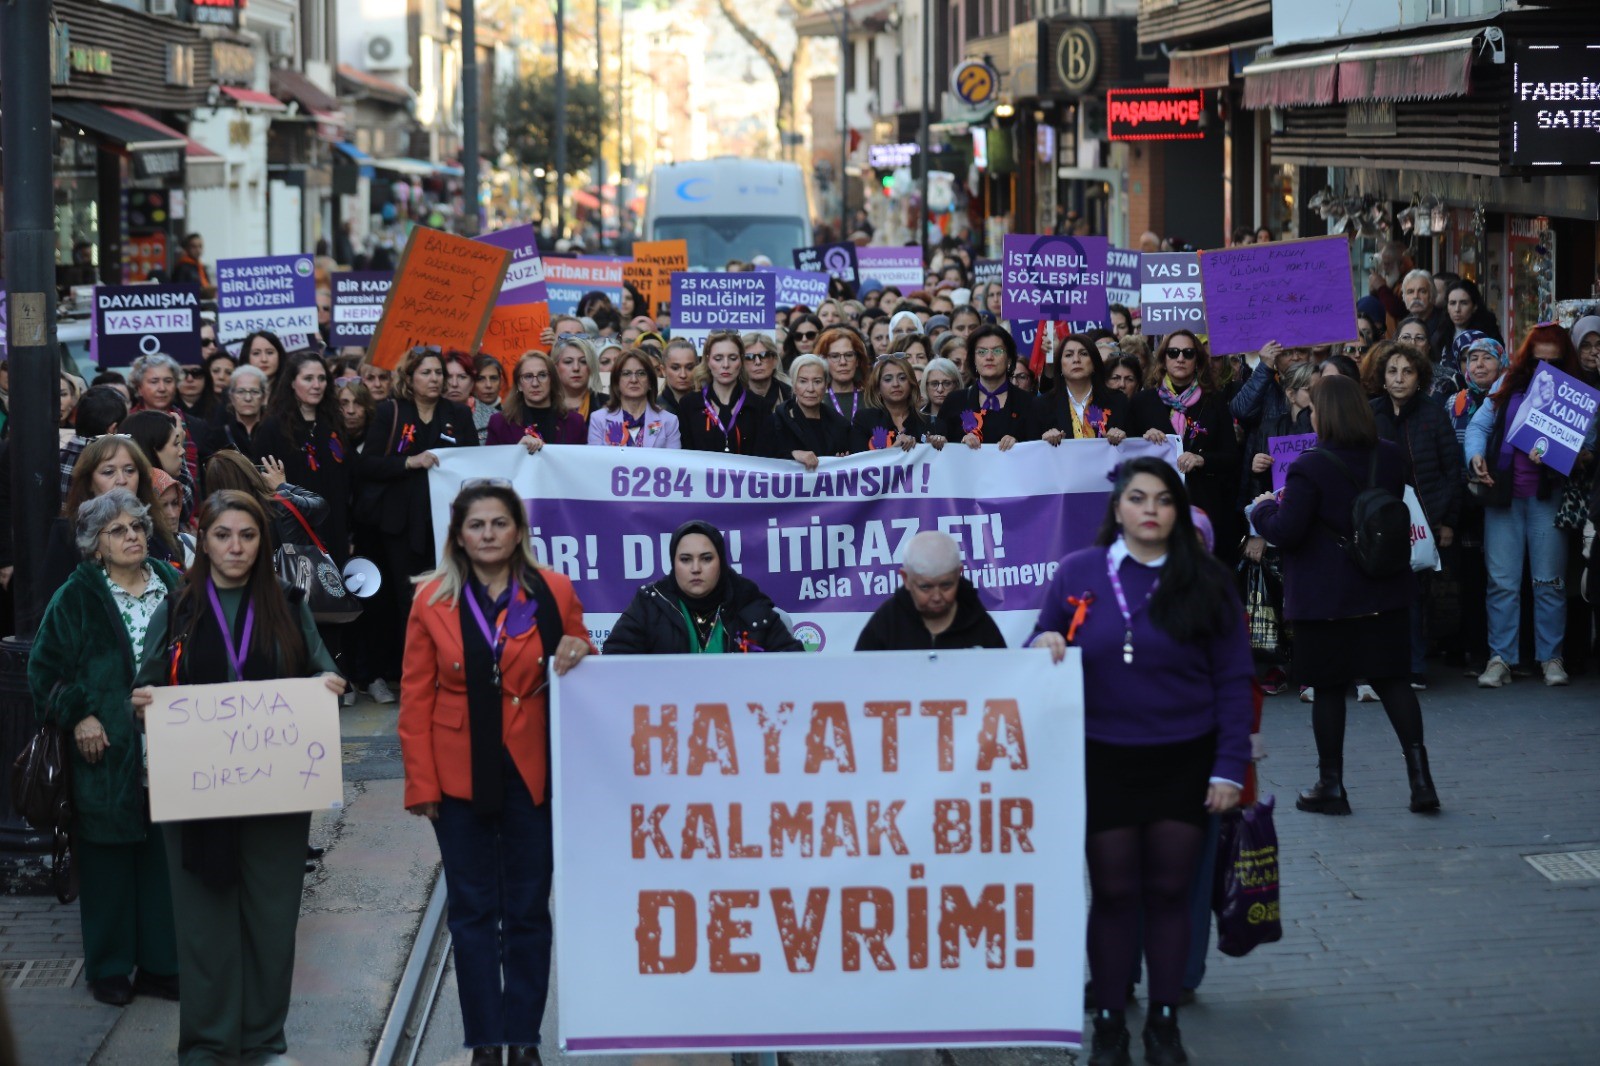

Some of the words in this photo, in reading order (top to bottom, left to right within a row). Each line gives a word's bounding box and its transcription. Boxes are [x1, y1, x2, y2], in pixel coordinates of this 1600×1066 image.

[1111, 100, 1200, 127] PAŞABAHÇE
[1008, 251, 1088, 267] İSTANBUL
[220, 267, 235, 279] 25
[591, 266, 622, 282] ELİNİ
[1008, 269, 1104, 287] SÖZLEŞMESİ
[1147, 264, 1182, 277] YAS
[221, 275, 294, 293] BİRLİĞİMİZ
[337, 278, 359, 292] BİR
[680, 278, 697, 289] 25
[700, 278, 765, 289] KASIM'DA
[782, 275, 826, 292] ÖZGÜR
[99, 292, 198, 309] DAYANIŞMA
[222, 297, 242, 308] BU
[244, 290, 295, 307] DÜZENİ
[681, 291, 765, 306] BİRLİĞİMİZ
[1008, 289, 1087, 306] YAŞATIR!
[1162, 287, 1202, 300] YAŞ
[107, 314, 190, 331] YAŞATIR!
[681, 311, 702, 323] BU
[707, 309, 765, 324] DÜZENİ
[1557, 381, 1597, 413] ÖZGÜR
[1550, 401, 1589, 431] KADIN
[1530, 413, 1547, 428] EŞİT
[1548, 422, 1580, 447] TOPLUM!
[611, 465, 693, 498] 6284
[705, 463, 914, 499] UYGULANSIN
[528, 526, 599, 581] ÖR!
[622, 530, 743, 580] DU!
[767, 515, 920, 573] İTİRAZ
[937, 513, 1005, 562] ET!
[799, 575, 852, 601] Asla
[858, 570, 903, 596] Yal
[166, 692, 294, 725] SUSMA
[223, 723, 299, 755] YÜRÜ
[630, 698, 1029, 776] HAYATTA
[192, 763, 273, 790] DİREN
[630, 800, 910, 860] KALMAK
[933, 781, 1036, 855] BİR
[635, 863, 1035, 976] DEVRİM!
